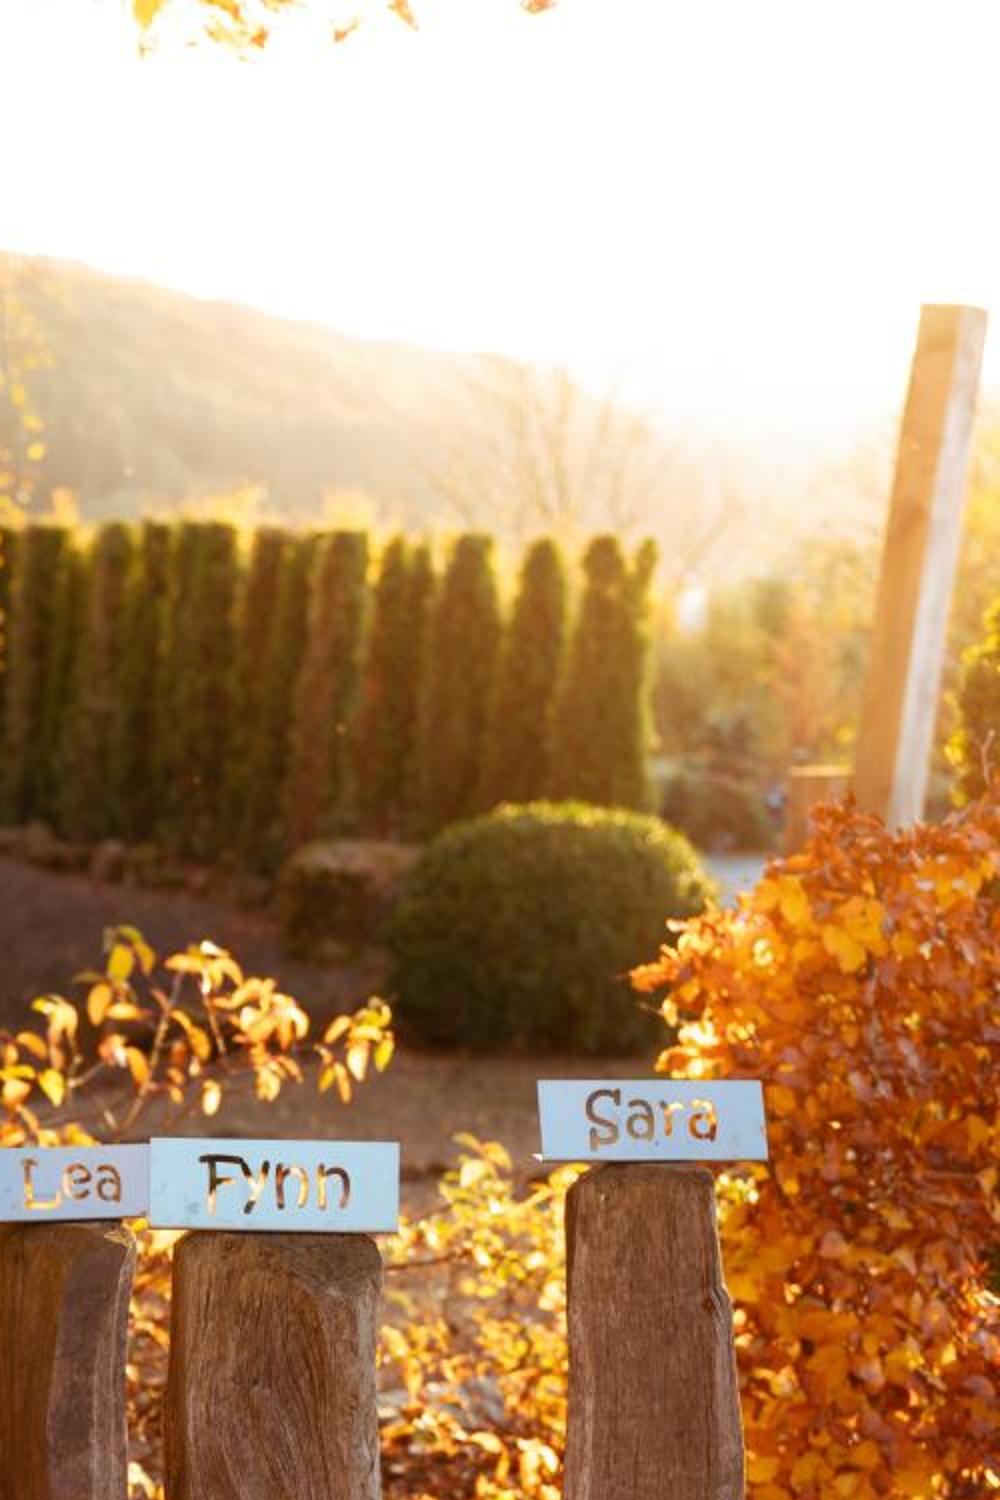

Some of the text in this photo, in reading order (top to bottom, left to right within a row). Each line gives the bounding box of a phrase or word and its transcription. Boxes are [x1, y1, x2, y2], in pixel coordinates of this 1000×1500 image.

[585, 1087, 718, 1151] Sara
[21, 1157, 122, 1209] Lea
[199, 1153, 351, 1215] Fynn
